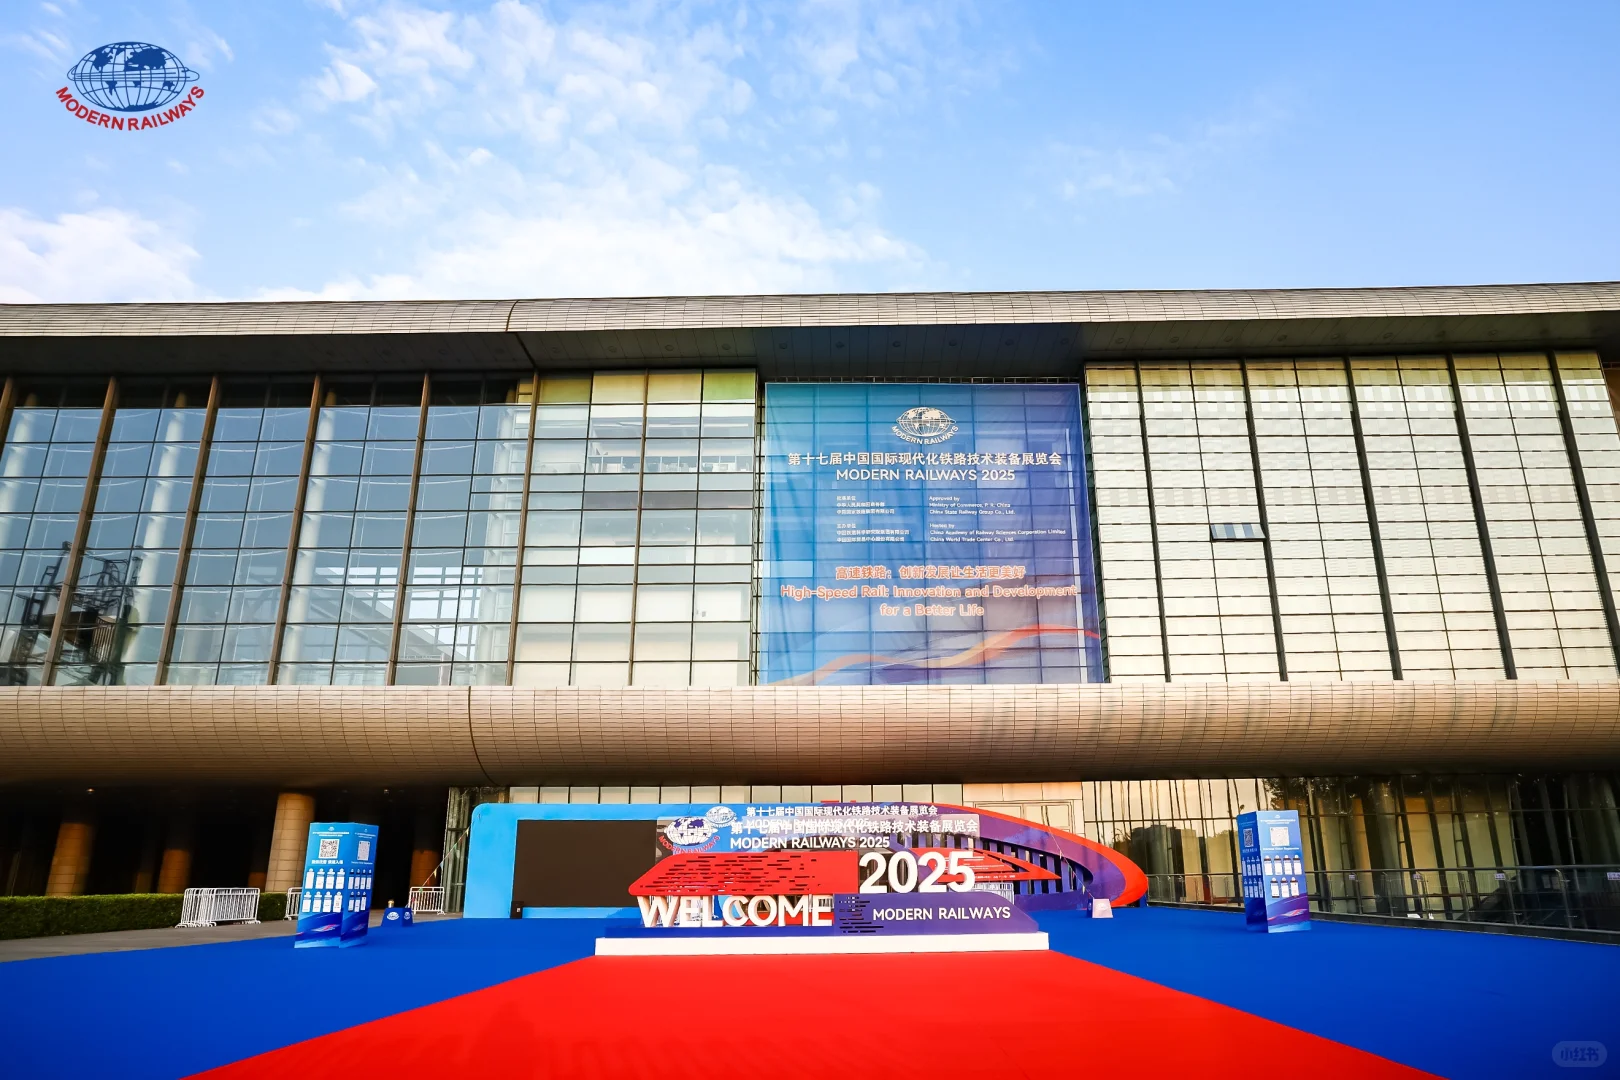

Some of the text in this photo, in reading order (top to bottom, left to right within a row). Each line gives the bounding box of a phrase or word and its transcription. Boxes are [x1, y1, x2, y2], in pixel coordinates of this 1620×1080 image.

[892, 426, 958, 444] MODERN RAILWAYS
[788, 452, 1062, 465] 第十七届中国国际现代化铁路技术装备展览会
[837, 469, 1015, 480] MODERN RAILWAYS 2025
[781, 584, 1078, 601] High-Speed Rail: Innovation and Development
[880, 603, 985, 616] for a Better Life
[746, 805, 938, 816] 第十七届中国国际现代化铁路技术装备展览会
[730, 836, 890, 849] MODERN RAILWAYS 2025
[859, 851, 975, 893] 2025
[637, 895, 833, 927] WELCOME
[873, 907, 1011, 921] MODERN RAILWAYS
